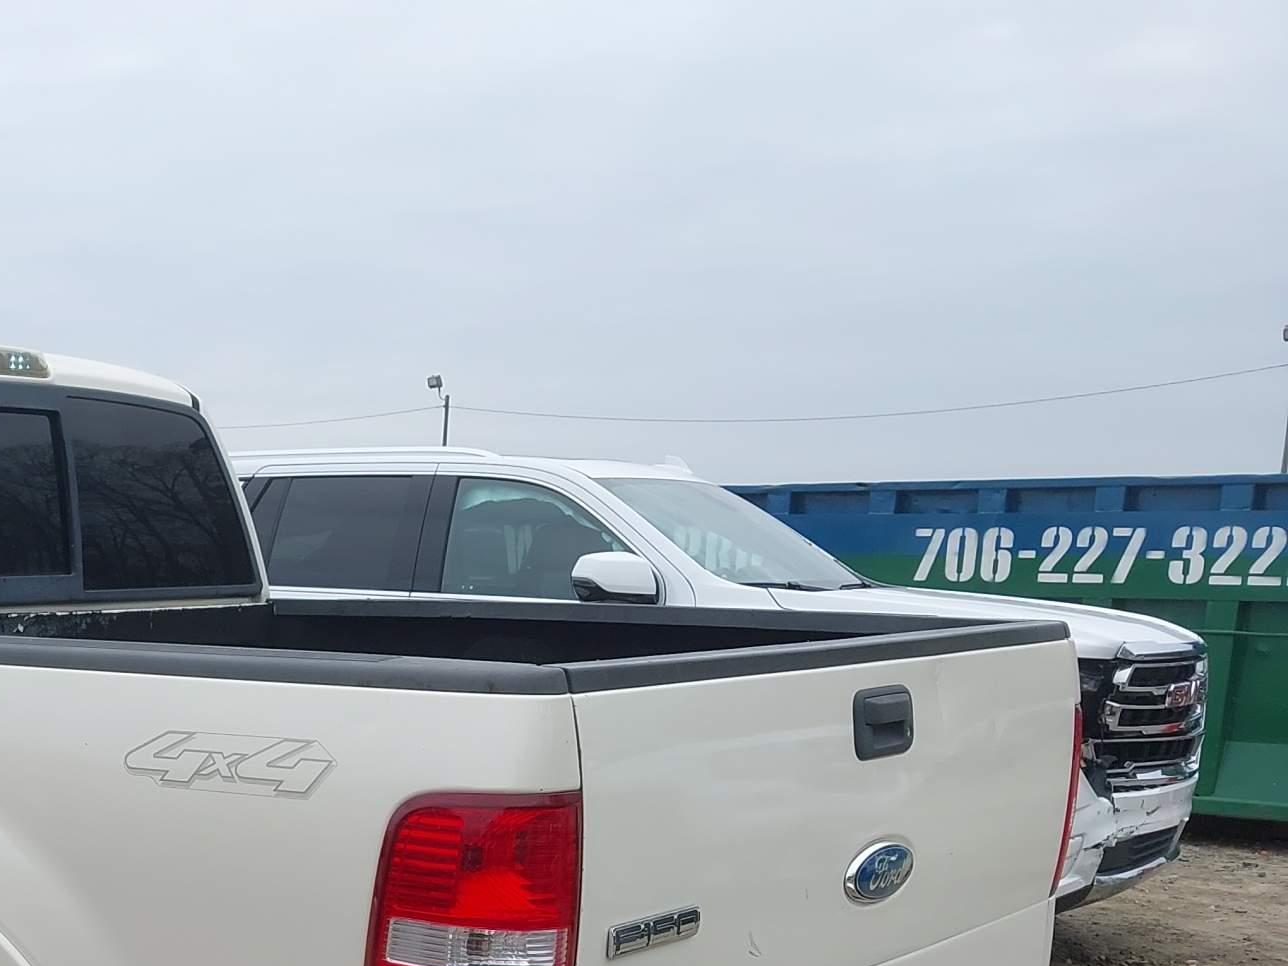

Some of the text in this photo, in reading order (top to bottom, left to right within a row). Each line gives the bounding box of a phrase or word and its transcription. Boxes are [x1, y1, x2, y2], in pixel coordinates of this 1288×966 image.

[912, 525, 1288, 586] 706-227-322
[124, 730, 335, 799] 4x4
[869, 852, 906, 891] Ford
